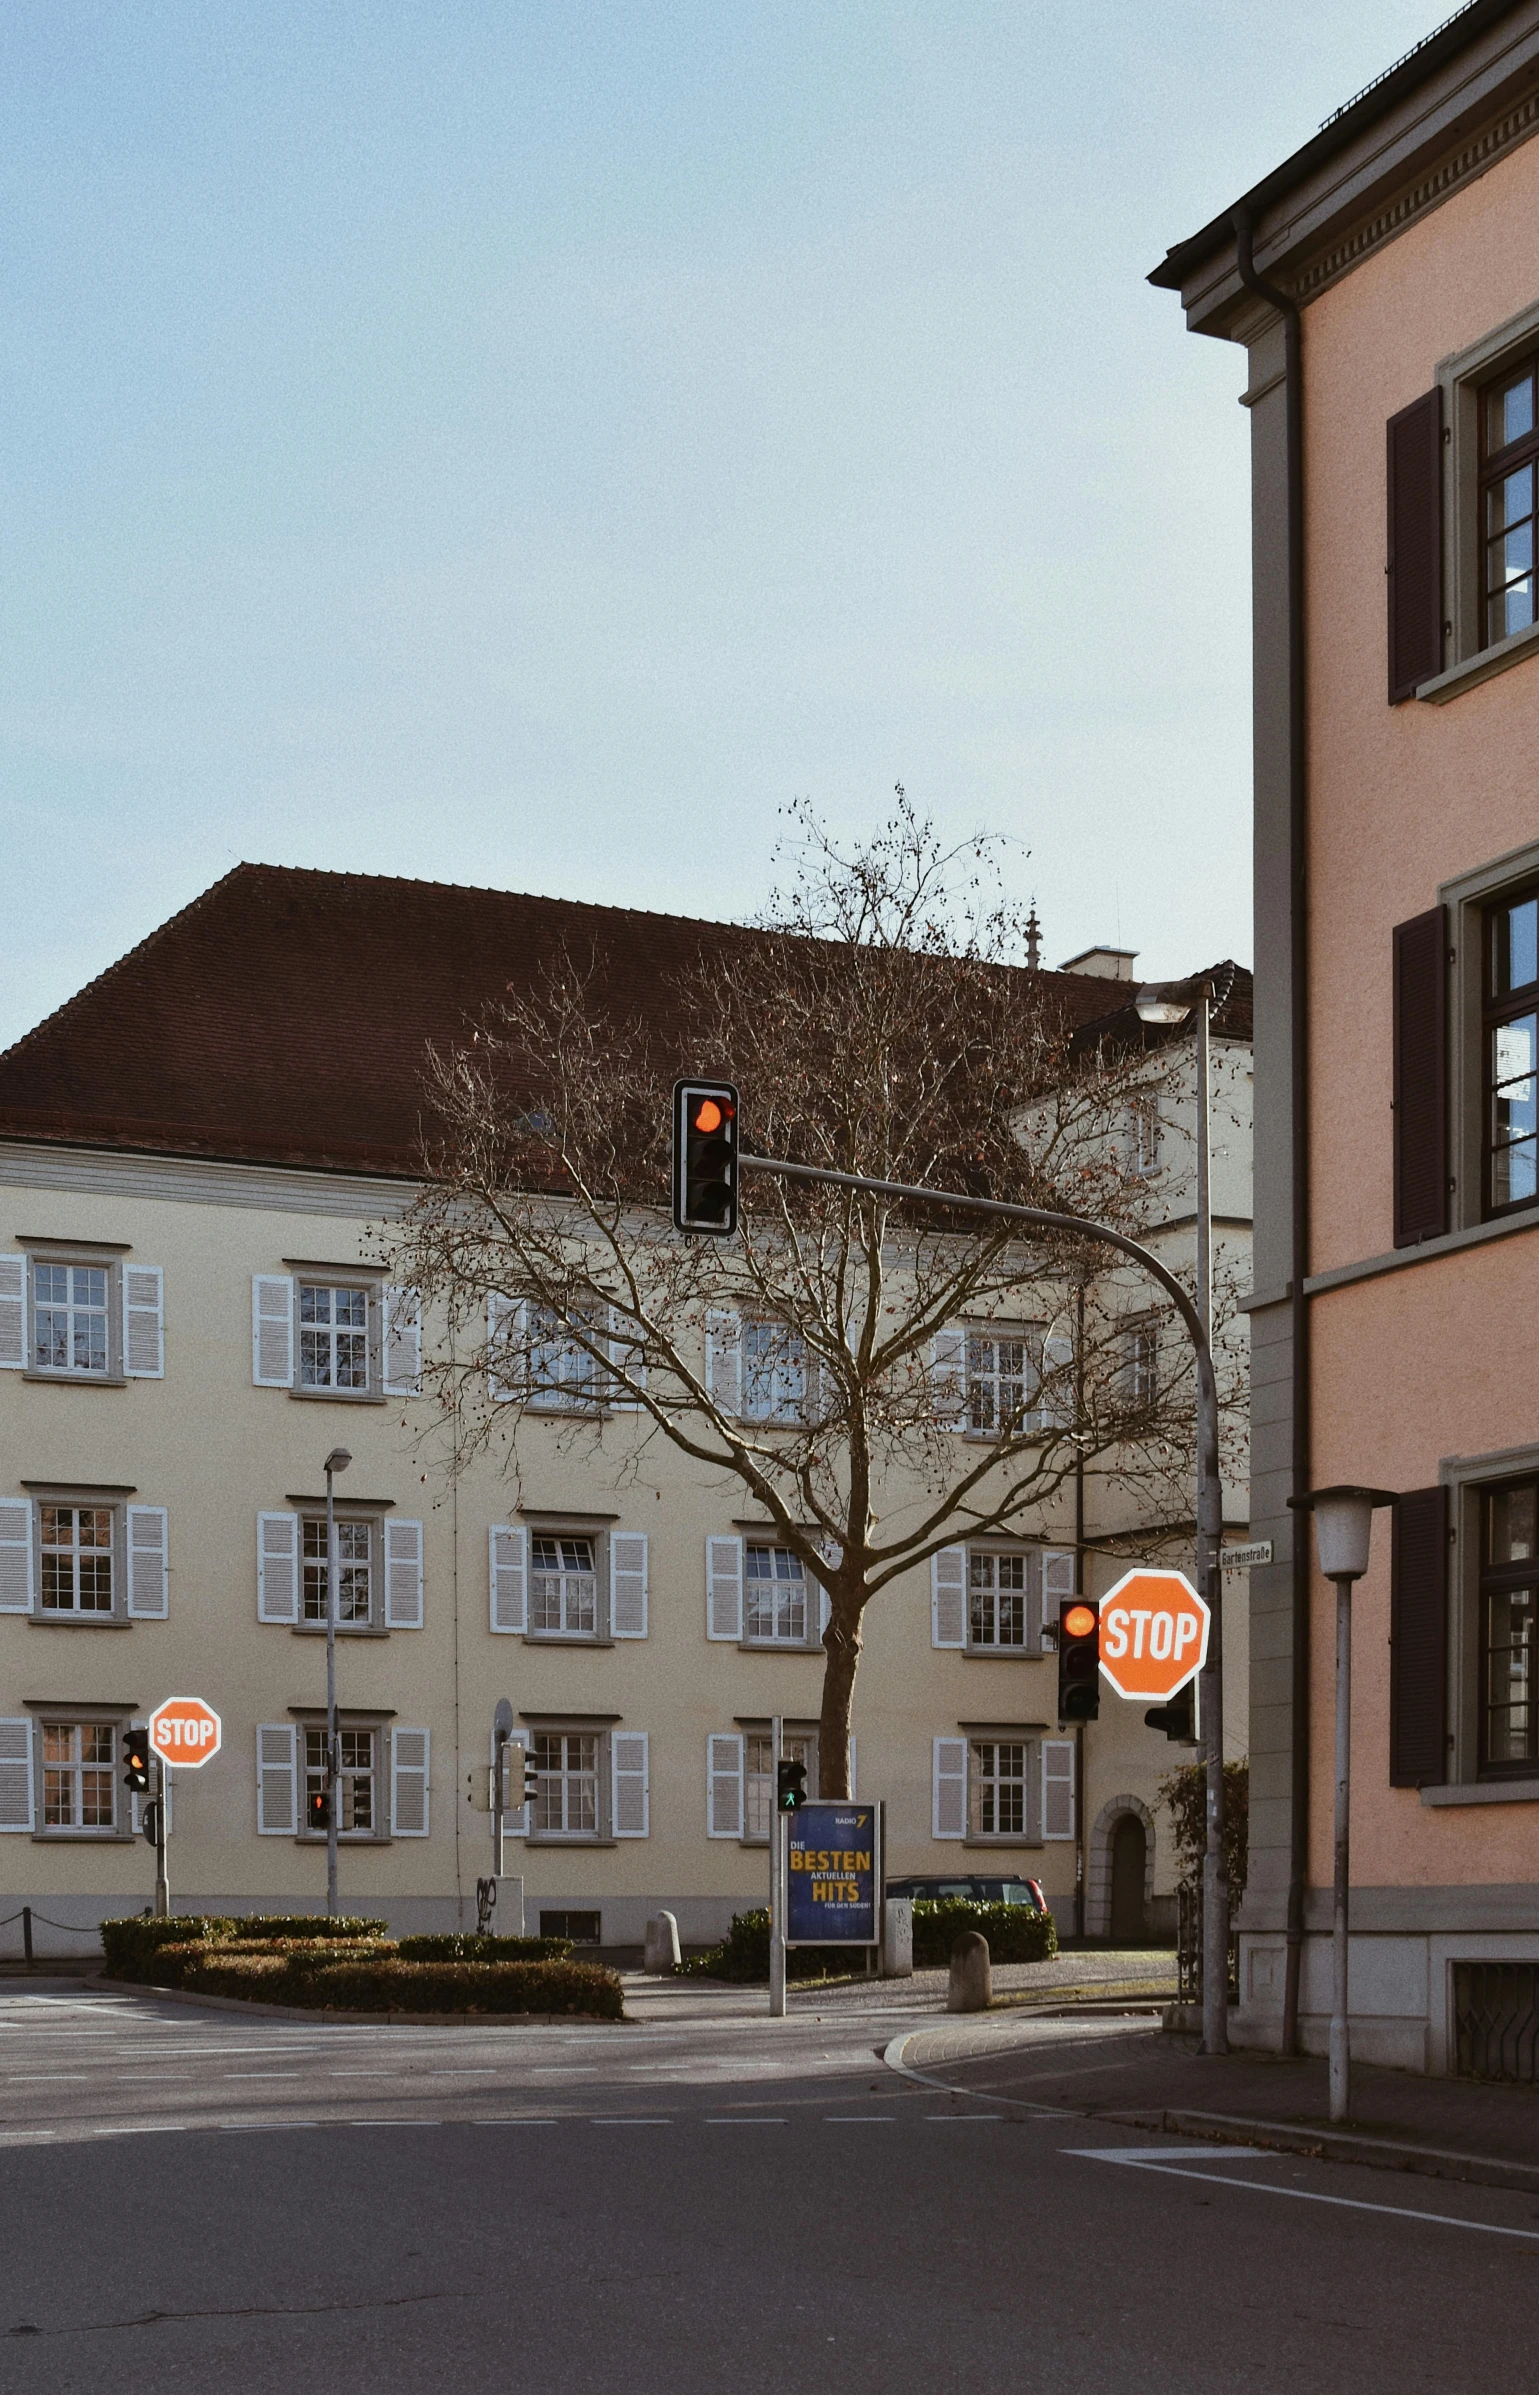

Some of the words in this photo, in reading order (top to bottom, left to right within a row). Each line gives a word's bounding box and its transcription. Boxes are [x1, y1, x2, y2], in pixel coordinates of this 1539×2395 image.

[1222, 1546, 1270, 1566] Gartenstraße
[1105, 1608, 1198, 1661] STOP
[157, 1718, 214, 1747] STOP
[835, 1817, 857, 1825] RADIO
[790, 1841, 805, 1850] DIE
[790, 1851, 871, 1871] BESTEN
[810, 1872, 856, 1880] AKTUELLEN
[812, 1882, 860, 1902] HITS
